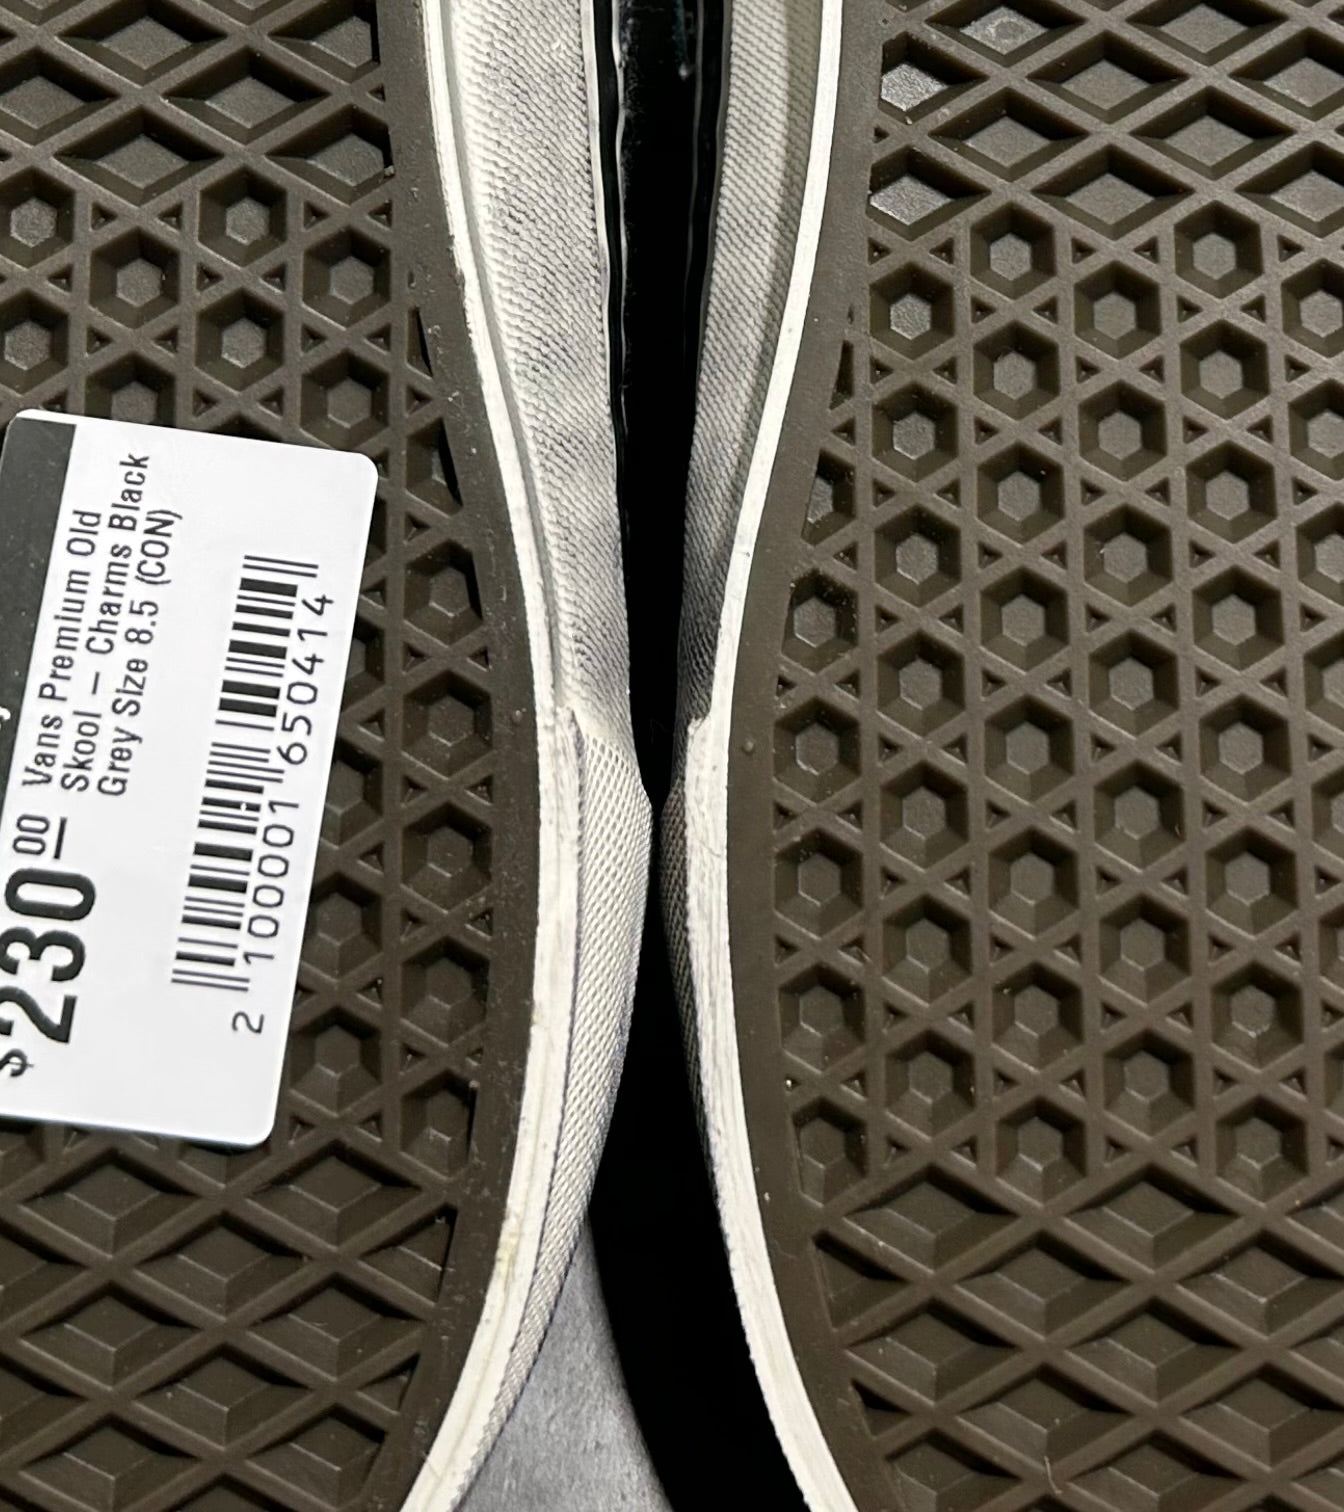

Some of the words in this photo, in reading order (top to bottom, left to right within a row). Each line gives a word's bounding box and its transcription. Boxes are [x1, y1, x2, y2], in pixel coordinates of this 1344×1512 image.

[106, 452, 150, 532] Black
[64, 508, 102, 557] Old
[133, 508, 183, 586] (CON)
[36, 568, 91, 702] Premium
[83, 542, 133, 655] Charms
[123, 599, 159, 646] 8.5
[109, 657, 149, 717] Size
[276, 593, 334, 766] 650414
[20, 713, 64, 787] Vans
[58, 709, 102, 793] Skool
[95, 725, 143, 797] Grey
[241, 799, 300, 965] 100001
[230, 1010, 265, 1035] 2
